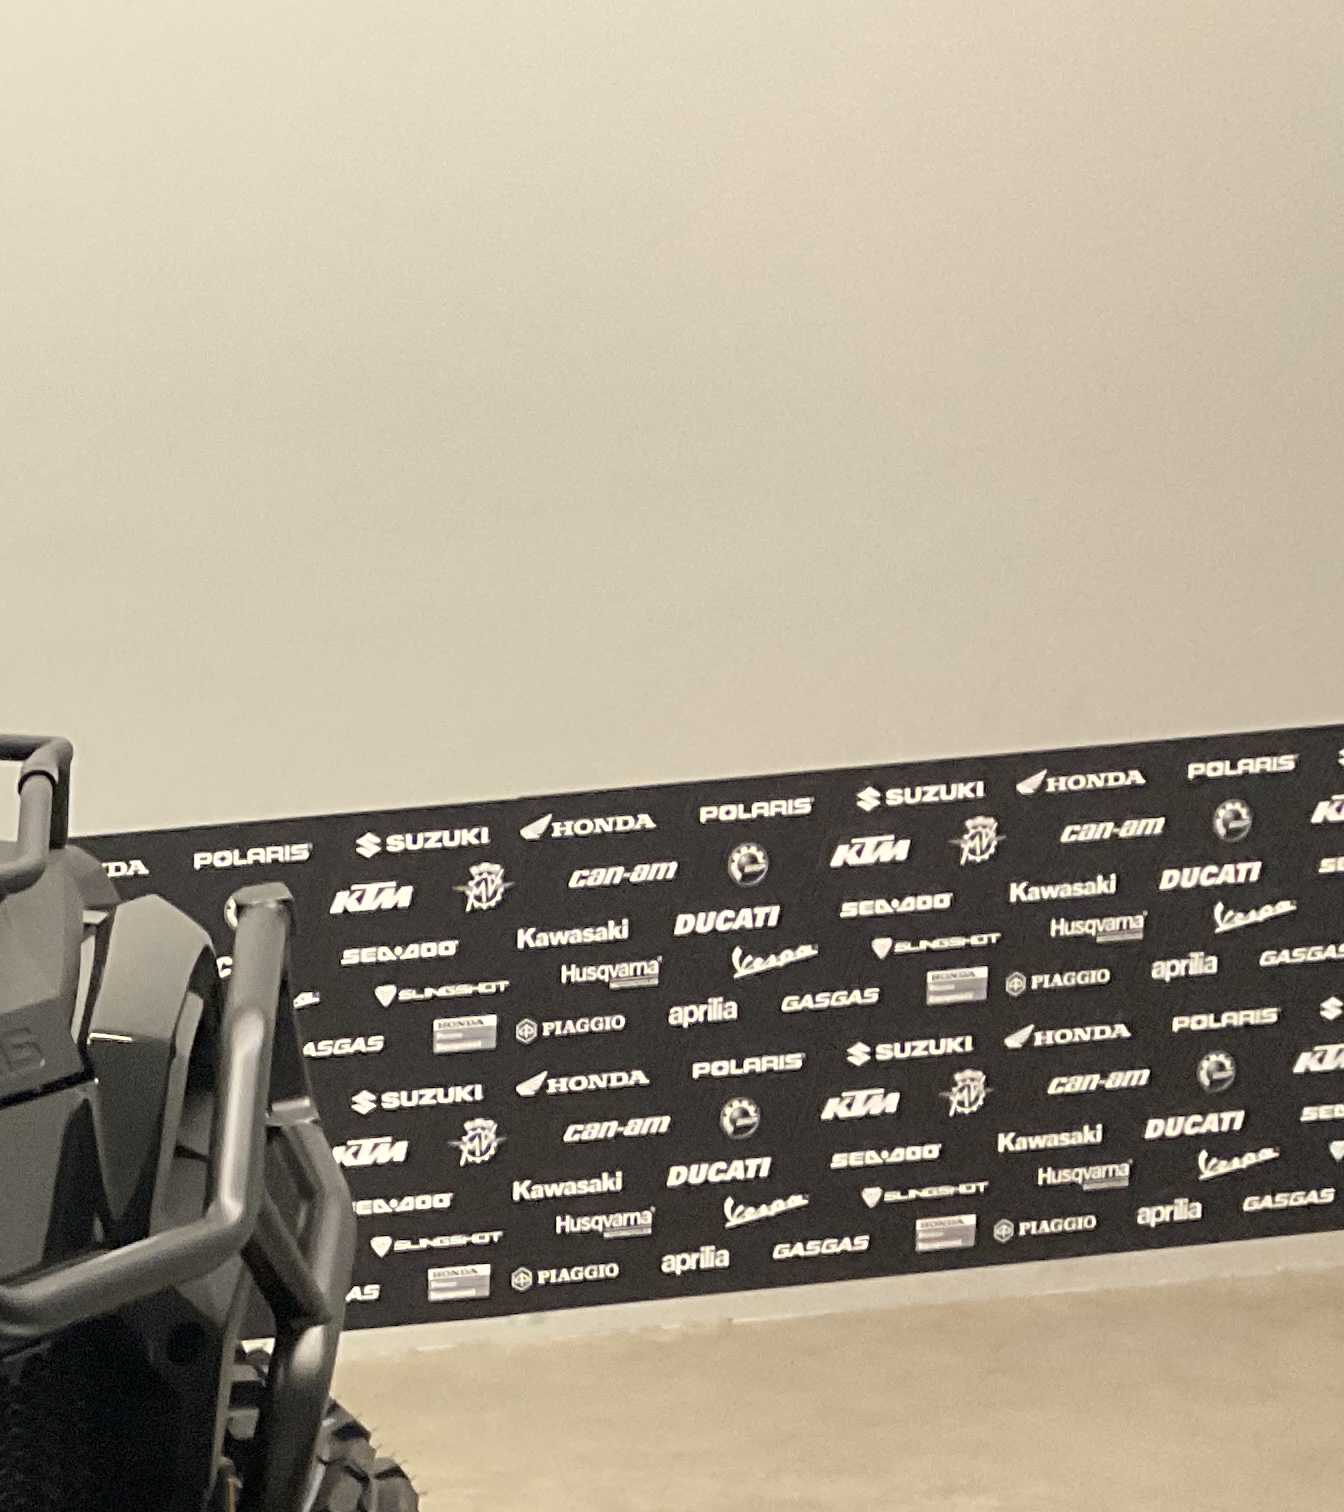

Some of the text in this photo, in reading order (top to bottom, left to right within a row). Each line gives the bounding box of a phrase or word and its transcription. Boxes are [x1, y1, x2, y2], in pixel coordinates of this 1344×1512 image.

[1187, 754, 1298, 780] POLARIS
[886, 781, 985, 806] SUZUKI
[1045, 769, 1146, 793] HONDA
[700, 797, 814, 824] POLARIS
[386, 826, 490, 852] SUZUKI
[551, 814, 656, 838] HONDA
[1060, 817, 1165, 843] can-am
[194, 843, 313, 870] POLARIS
[830, 834, 910, 868] KTM
[568, 861, 678, 888] can-am
[1010, 873, 1116, 903] Kawasaki
[1159, 861, 1262, 890] DUCATI
[330, 881, 414, 914] KTM
[674, 905, 780, 936] DUCATI
[1050, 913, 1145, 940] Husqvarna
[1214, 900, 1296, 933] Vespa
[517, 918, 628, 950] Kawasaki
[894, 933, 1001, 953] SLINGSHOT
[561, 958, 660, 987] Husqvarna
[732, 944, 818, 979] Vespa
[1151, 952, 1218, 983] aprilia
[398, 980, 510, 1001] SLINGSHOT
[1031, 969, 1110, 990] PIAGGIO
[668, 997, 737, 1028] aprilia
[781, 988, 880, 1012] GASGAS
[542, 1015, 625, 1036] PIAGGIO
[1172, 1008, 1281, 1032] POLARIS
[302, 1035, 385, 1057] ASGAS
[876, 1036, 974, 1061] SUZUKI
[1033, 1024, 1131, 1047] HONDA
[692, 1053, 805, 1079] POLARIS
[547, 1070, 649, 1094] HONDA
[1047, 1069, 1150, 1094] can-am
[381, 1084, 484, 1109] SUZUKI
[821, 1088, 900, 1120] KTM
[563, 1116, 671, 1142] can-am
[1144, 1110, 1245, 1139] DUCATI
[332, 1136, 409, 1167] KTM
[998, 1124, 1102, 1153] Kawasaki
[667, 1157, 772, 1187] DUCATI
[1038, 1161, 1130, 1188] Husqvarna
[1198, 1148, 1279, 1180] Vespa
[513, 1171, 622, 1201] Kawasaki
[884, 1181, 989, 1202] SLINGSHOT
[1243, 1188, 1335, 1211] GASGAS
[556, 1208, 653, 1236] Husqvarna
[724, 1194, 809, 1228] Vespa
[1137, 1198, 1202, 1228] aprilia
[1019, 1215, 1096, 1236] PIAGGIO
[394, 1231, 503, 1252] SLINGSHOT
[773, 1235, 869, 1259] GASGAS
[661, 1245, 729, 1275] aprilia
[537, 1263, 619, 1285] PIAGGIO
